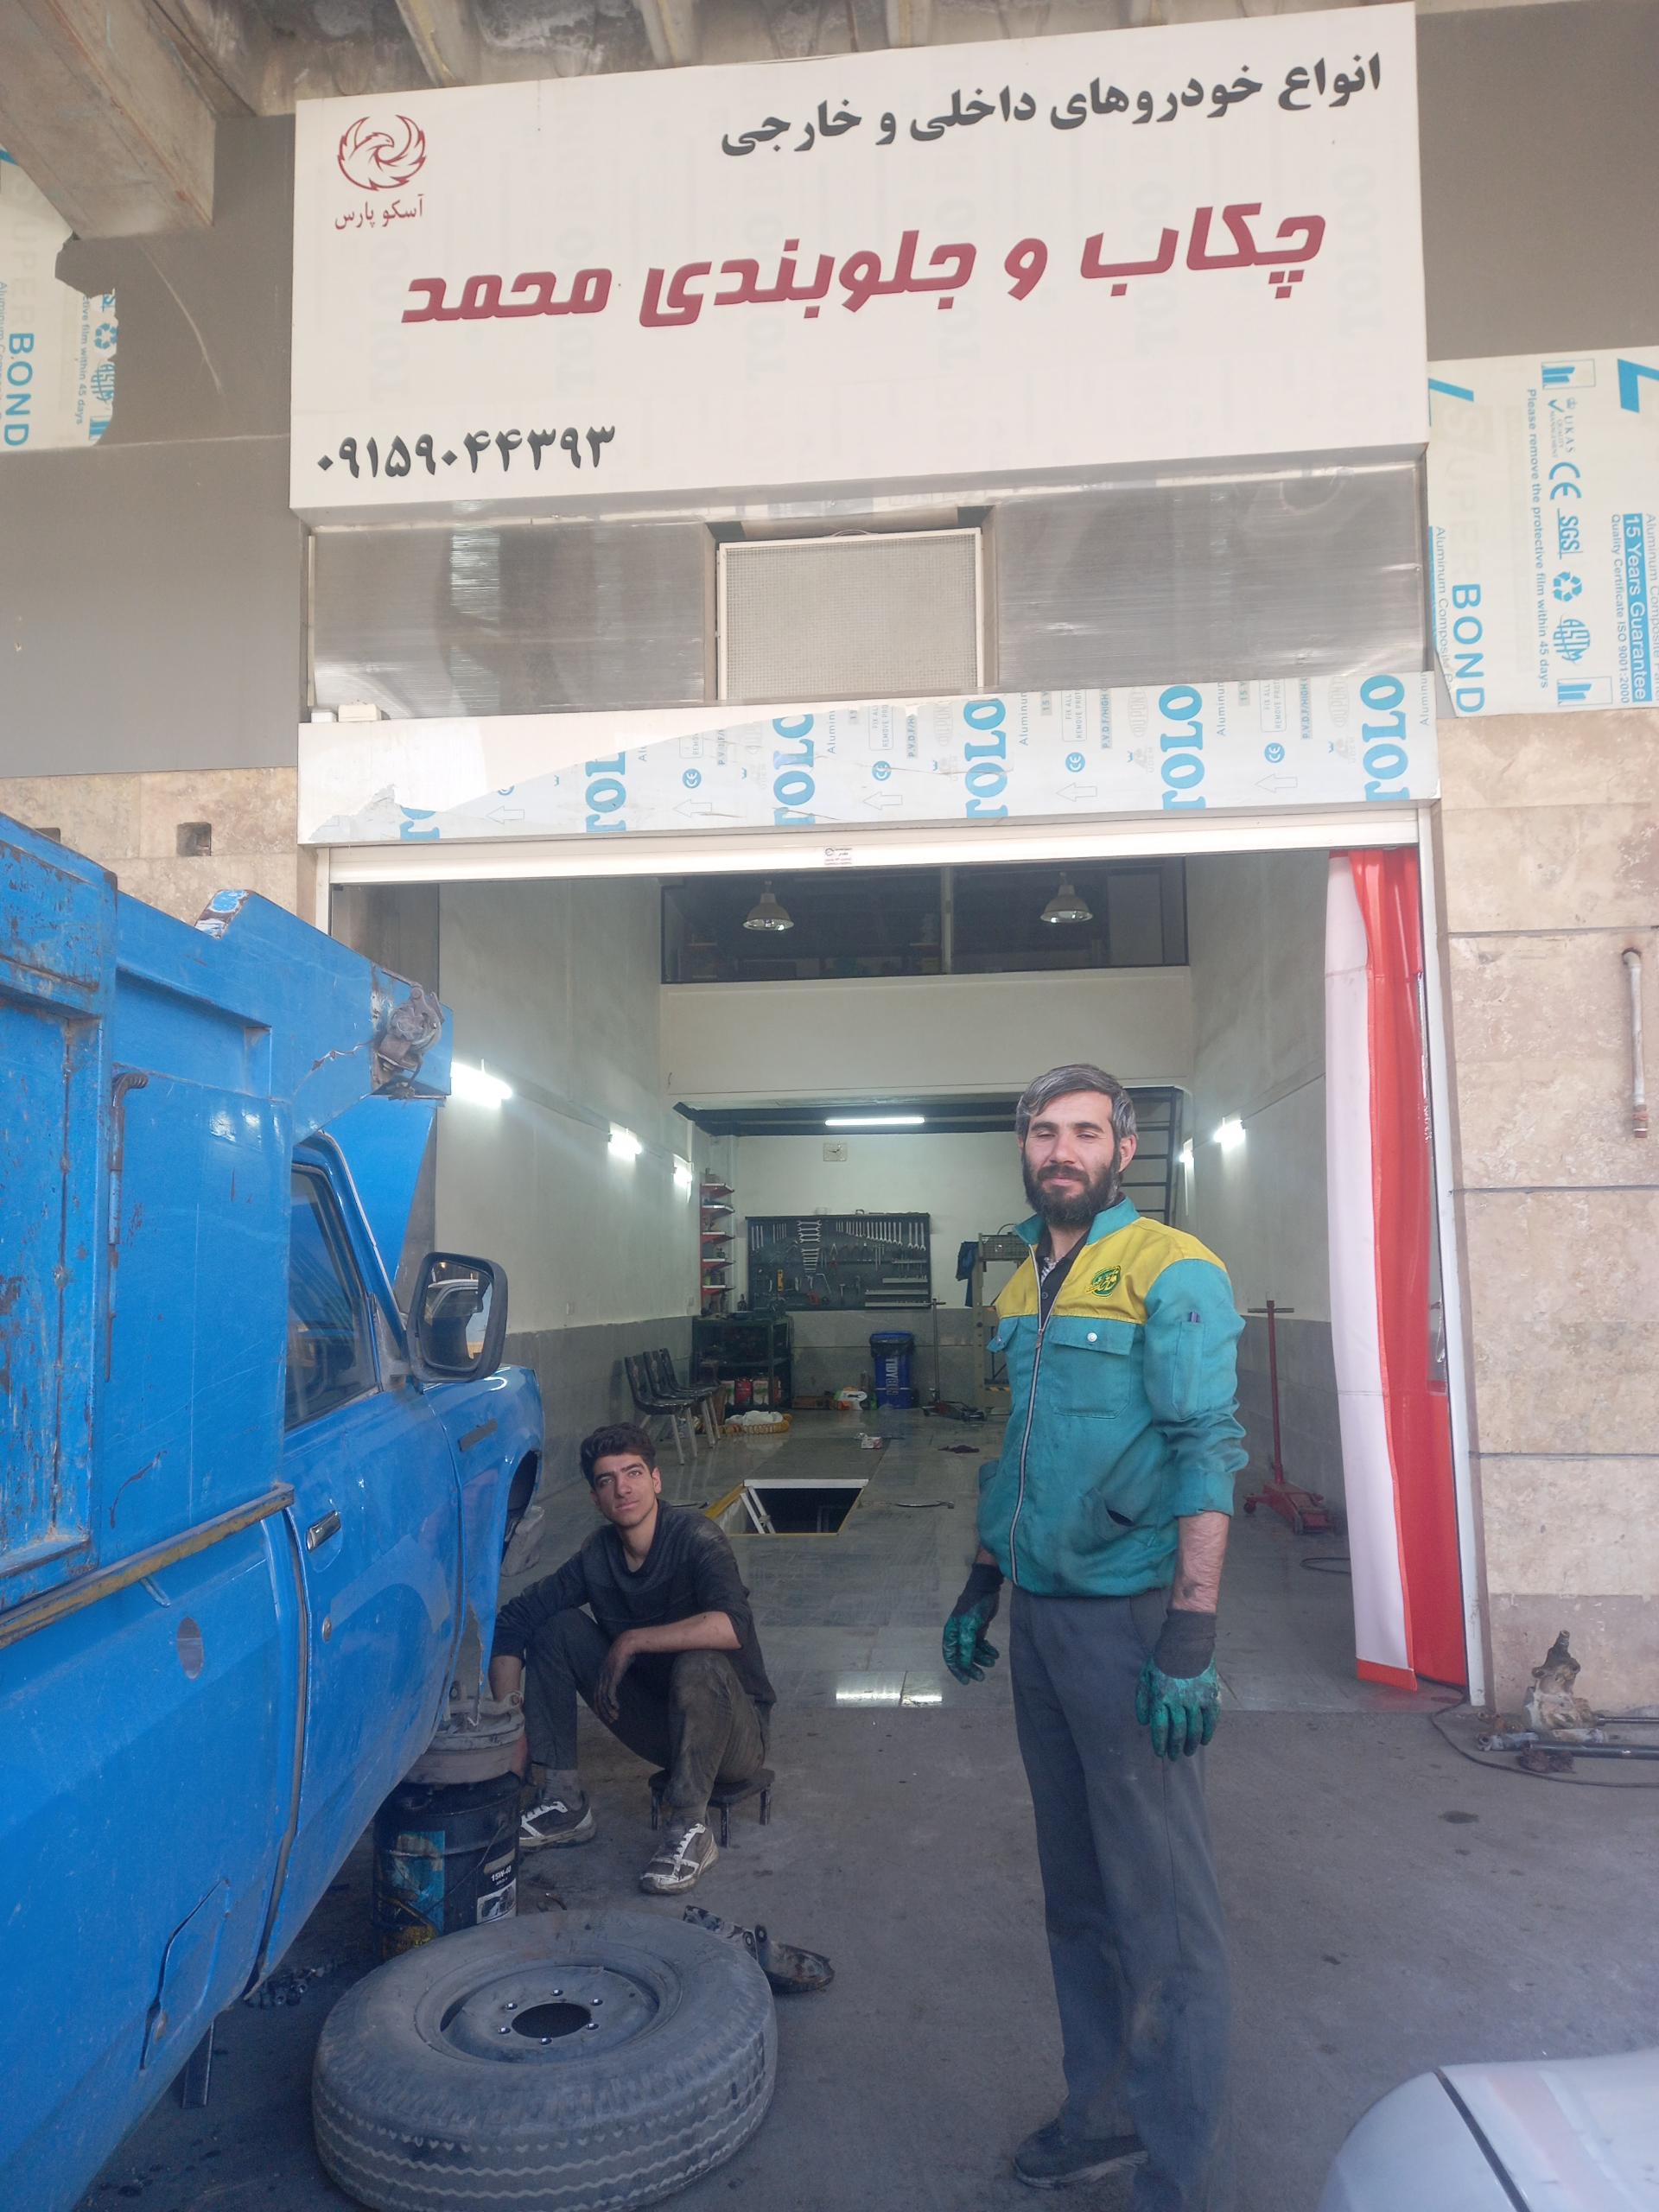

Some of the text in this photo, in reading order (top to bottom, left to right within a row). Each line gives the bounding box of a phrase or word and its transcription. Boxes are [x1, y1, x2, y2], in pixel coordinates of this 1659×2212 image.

[721, 53, 1382, 156] انواع خودروهای داخلی و خارجی
[334, 193, 425, 231] آسکو پارس
[639, 229, 977, 327] جلوبندی
[1003, 238, 1048, 301] و
[1080, 202, 1326, 299] چکاب
[401, 268, 613, 324] محمد
[4, 332, 35, 447] BOND
[316, 424, 615, 479] ۰۹۱۵۹۰۴۴۳۹۳
[1435, 525, 1446, 594] Aluminum
[1527, 388, 1550, 690] Please remove the protective film within 45 days
[1559, 515, 1580, 551] SGS
[1611, 513, 1623, 555] Quality
[1646, 512, 1658, 582] Aluminum
[1614, 558, 1625, 618] Certificate
[1624, 516, 1648, 700] 15 Years Guarantee
[1452, 583, 1486, 714] BOND
[1617, 621, 1627, 642] ISO
